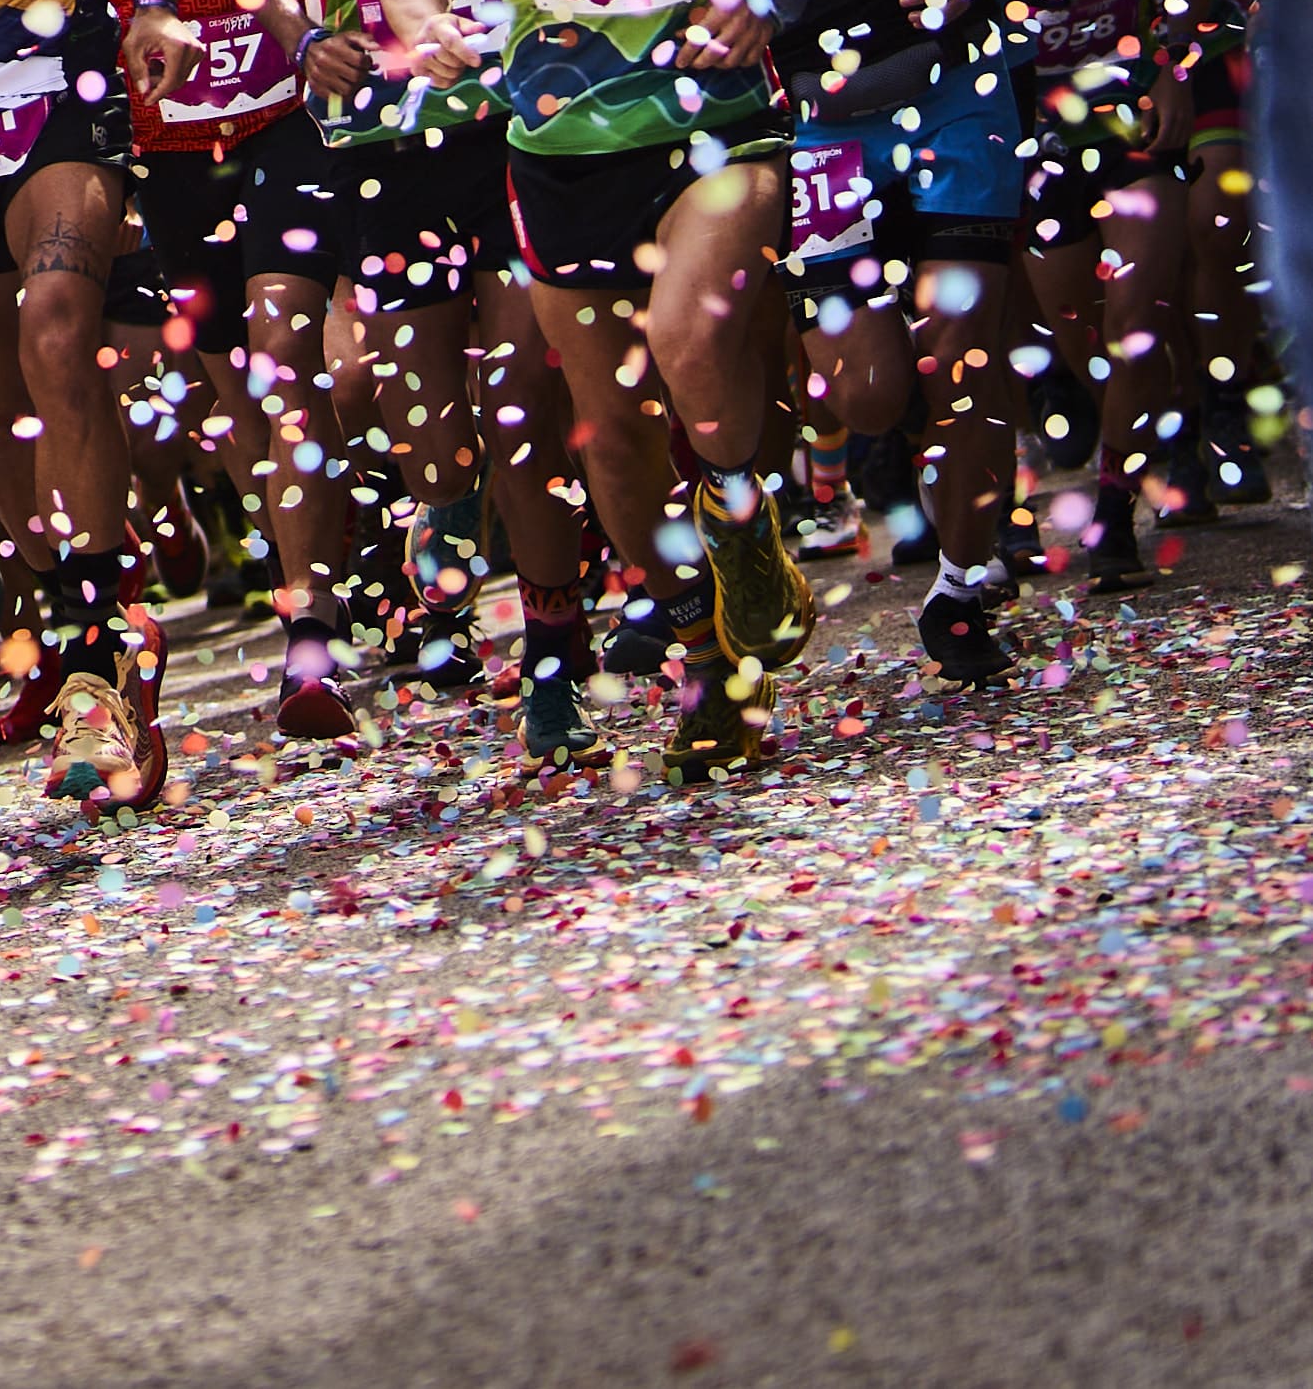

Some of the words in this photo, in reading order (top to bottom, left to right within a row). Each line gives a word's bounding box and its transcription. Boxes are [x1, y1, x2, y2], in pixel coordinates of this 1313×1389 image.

[1042, 14, 1116, 51] 958
[209, 77, 242, 88] IMANOL
[668, 595, 702, 617] NEVER
